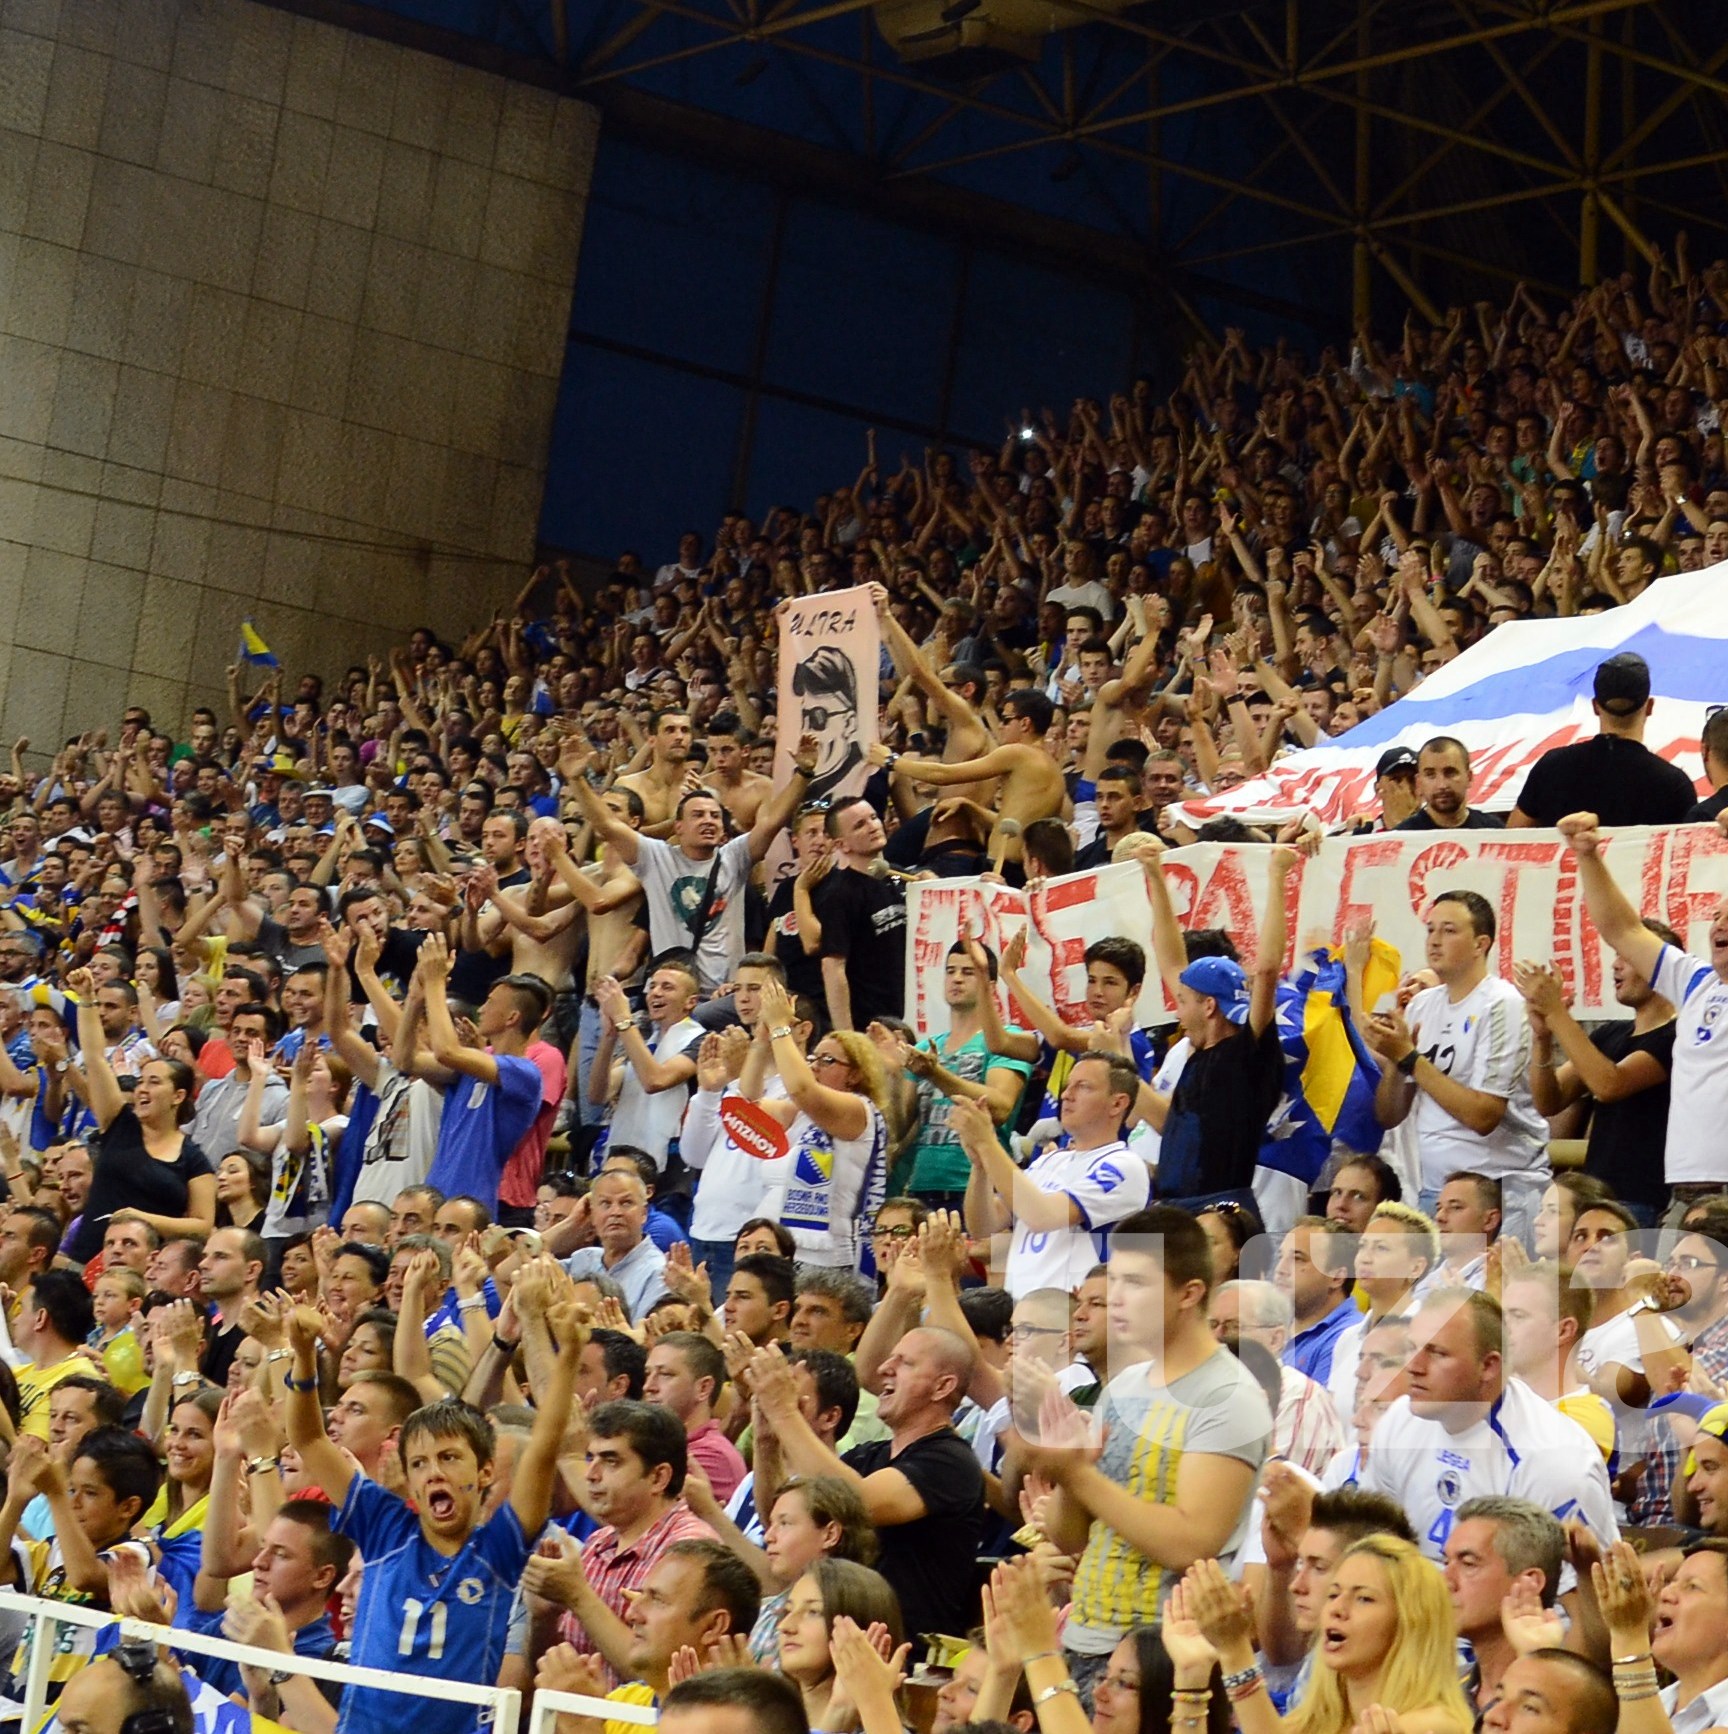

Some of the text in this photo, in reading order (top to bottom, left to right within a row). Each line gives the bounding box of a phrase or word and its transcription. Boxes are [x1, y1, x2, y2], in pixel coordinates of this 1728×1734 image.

[790, 607, 856, 637] ULTRA
[916, 874, 1098, 1033] FREE
[722, 1111, 778, 1158] KONZUM
[398, 1597, 448, 1660] 11
